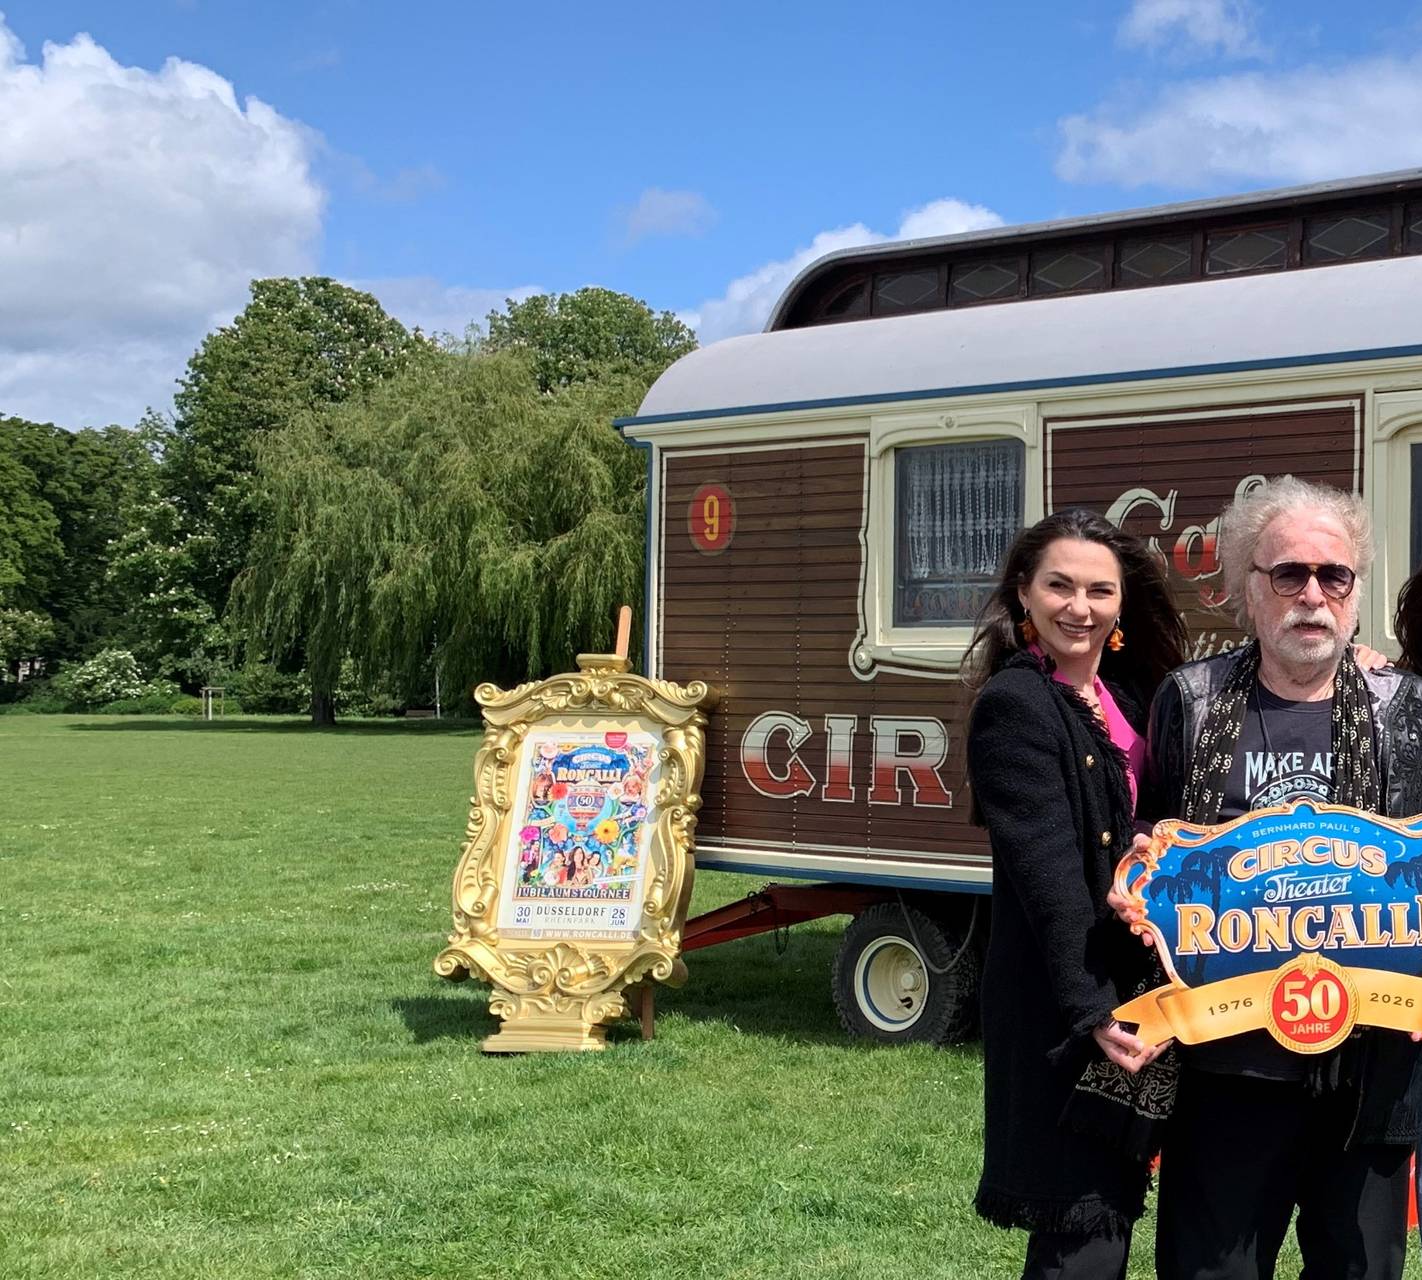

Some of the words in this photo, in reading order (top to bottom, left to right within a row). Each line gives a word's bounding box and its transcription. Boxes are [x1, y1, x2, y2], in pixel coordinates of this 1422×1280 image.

[703, 494, 720, 542] 9
[740, 710, 952, 808] CIR
[1245, 751, 1305, 800] MAKE
[579, 796, 593, 805] 50
[1252, 822, 1316, 838] BERNHARD
[1319, 821, 1361, 834] PAUL'S
[1228, 835, 1388, 883] CIRCUS
[1263, 870, 1353, 904] Theater
[516, 906, 531, 917] 30
[611, 908, 626, 919] 28
[1207, 997, 1254, 1016] 1976
[1279, 979, 1342, 1023] 50
[1369, 992, 1415, 1009] 2026
[1290, 1022, 1332, 1035] JAHRE
